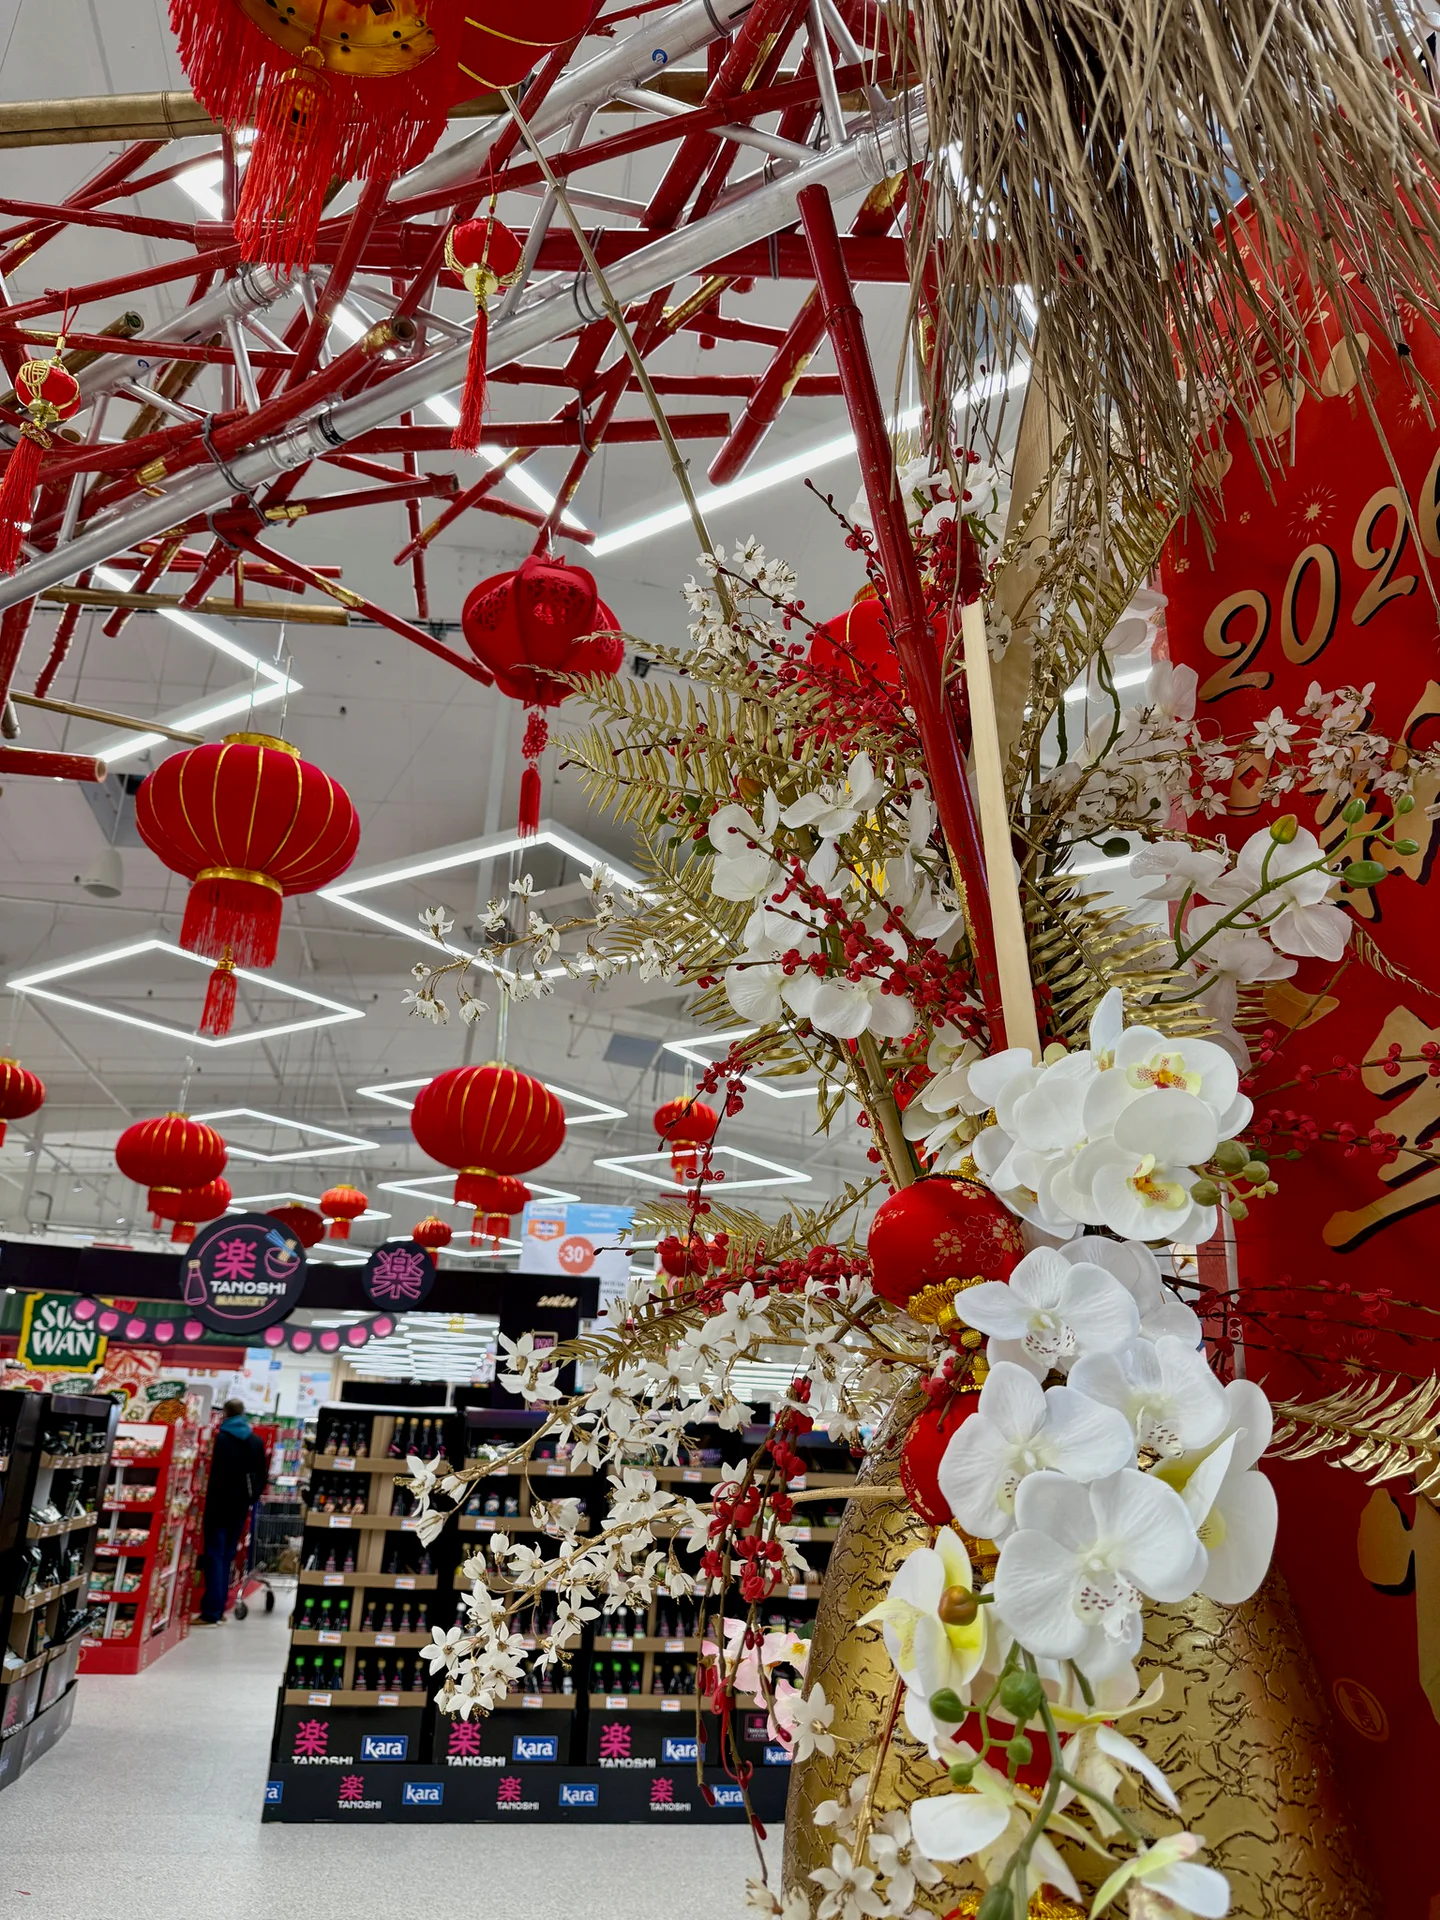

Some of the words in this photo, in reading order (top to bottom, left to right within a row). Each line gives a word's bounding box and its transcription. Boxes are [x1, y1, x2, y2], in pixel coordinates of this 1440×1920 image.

[213, 1238, 258, 1280] 楽
[210, 1280, 287, 1296] TANOSHI
[32, 1330, 96, 1356] WAN
[293, 1719, 329, 1755] 楽
[365, 1737, 403, 1759] kara
[516, 1738, 553, 1759] kara
[666, 1739, 699, 1761] kara
[445, 1756, 506, 1767] TANOSHI
[598, 1758, 656, 1768] TANOSHI
[406, 1784, 439, 1803] kara
[562, 1785, 595, 1804] kara
[713, 1786, 744, 1805] kara
[337, 1800, 382, 1809] TANOSHI
[496, 1802, 540, 1810] TANOSHI
[649, 1802, 691, 1811] TANOSHI
